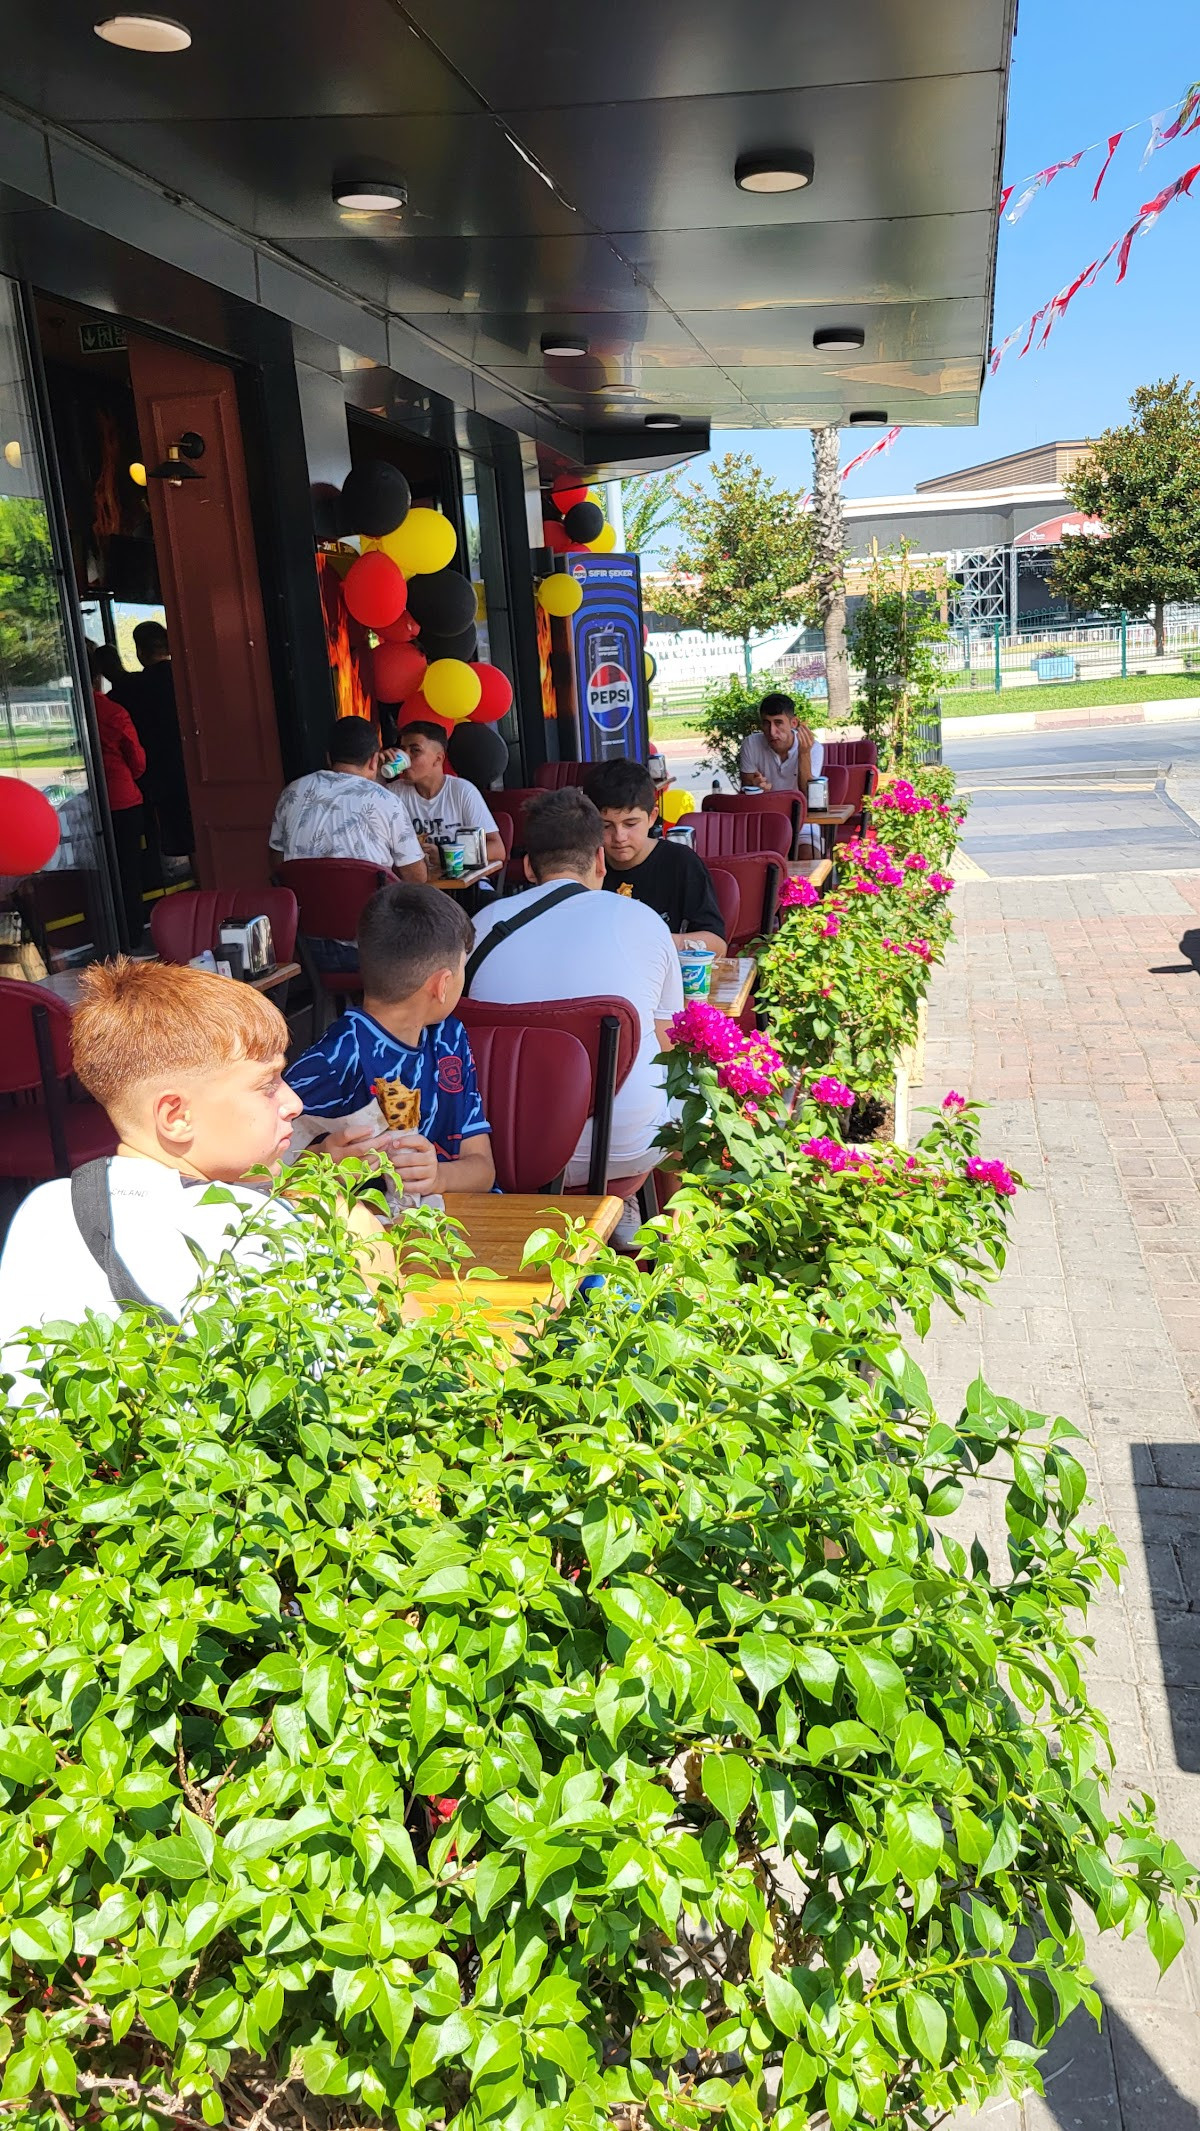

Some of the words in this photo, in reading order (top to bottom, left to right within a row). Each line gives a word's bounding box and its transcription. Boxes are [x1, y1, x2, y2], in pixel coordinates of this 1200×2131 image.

[588, 569, 608, 577] SIFIR
[608, 569, 633, 579] ŞEKER
[590, 689, 630, 705] PEPSI
